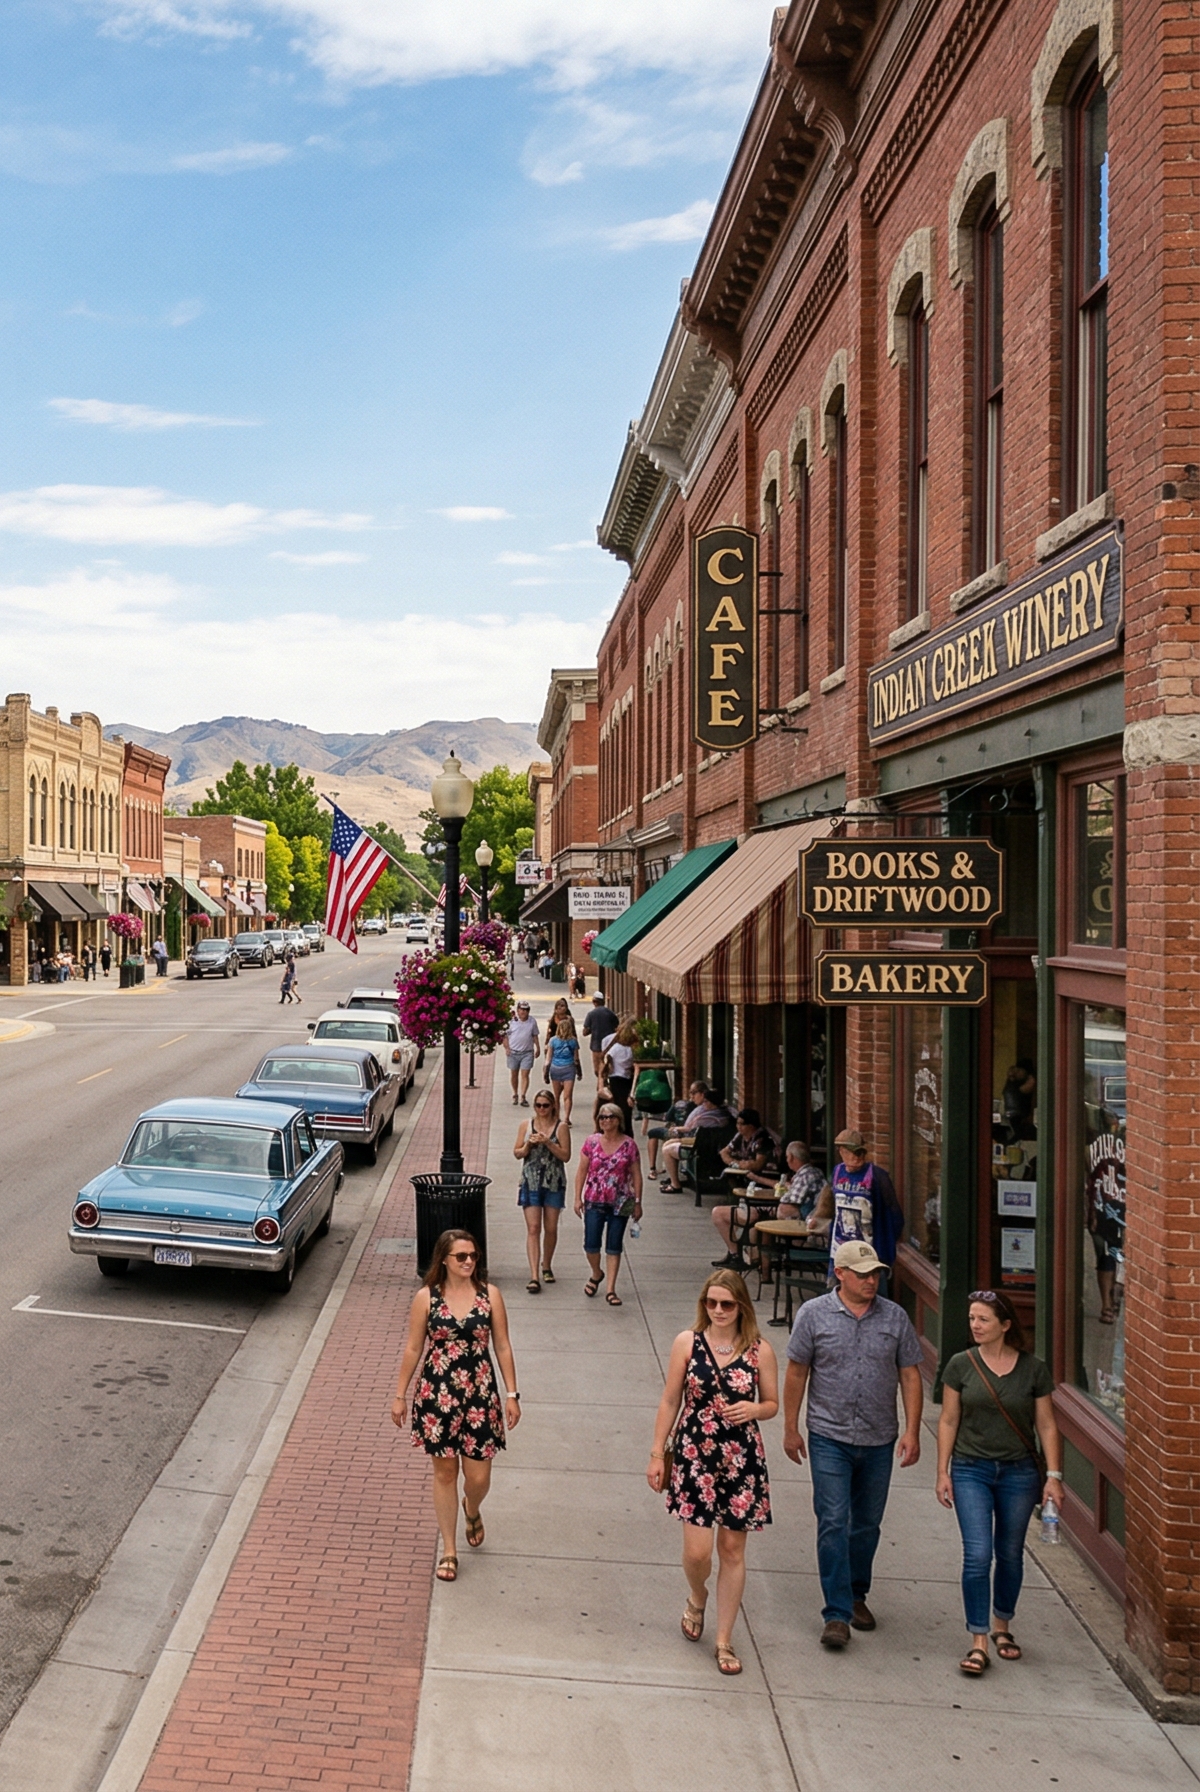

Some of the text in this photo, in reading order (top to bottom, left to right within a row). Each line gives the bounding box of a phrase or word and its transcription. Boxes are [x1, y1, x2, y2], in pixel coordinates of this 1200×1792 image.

[705, 547, 746, 727] CAFE
[873, 553, 1110, 728] INDIAN CREEK WINERY
[826, 851, 975, 880] BOOKS &
[812, 886, 991, 912] DRIFTWOOD
[830, 963, 974, 994] BAKERY
